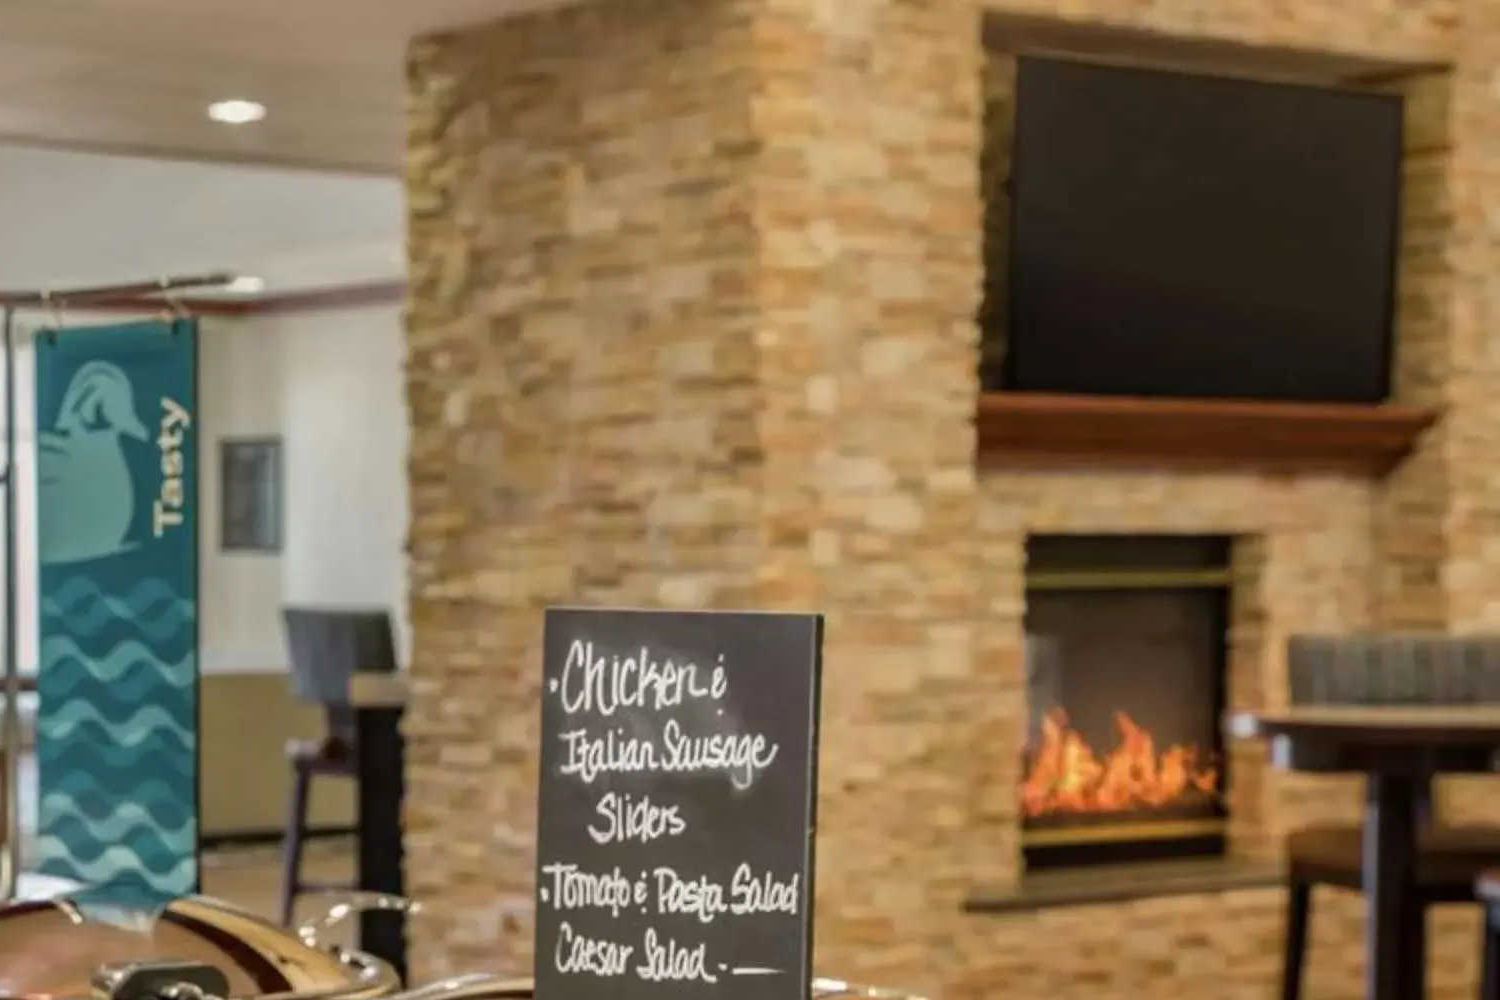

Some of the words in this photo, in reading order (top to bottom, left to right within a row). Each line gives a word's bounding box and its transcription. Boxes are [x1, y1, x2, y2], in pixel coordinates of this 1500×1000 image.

[153, 397, 191, 538] Tasty
[561, 640, 708, 716] Chicken
[558, 728, 658, 782] Italian
[661, 719, 779, 789] Sausage
[588, 792, 686, 844] Sliders
[543, 862, 631, 917] Tomato
[653, 866, 728, 922] Pasta
[730, 862, 799, 915] Salad
[555, 921, 634, 976] Caesar
[636, 927, 718, 983] Salad
